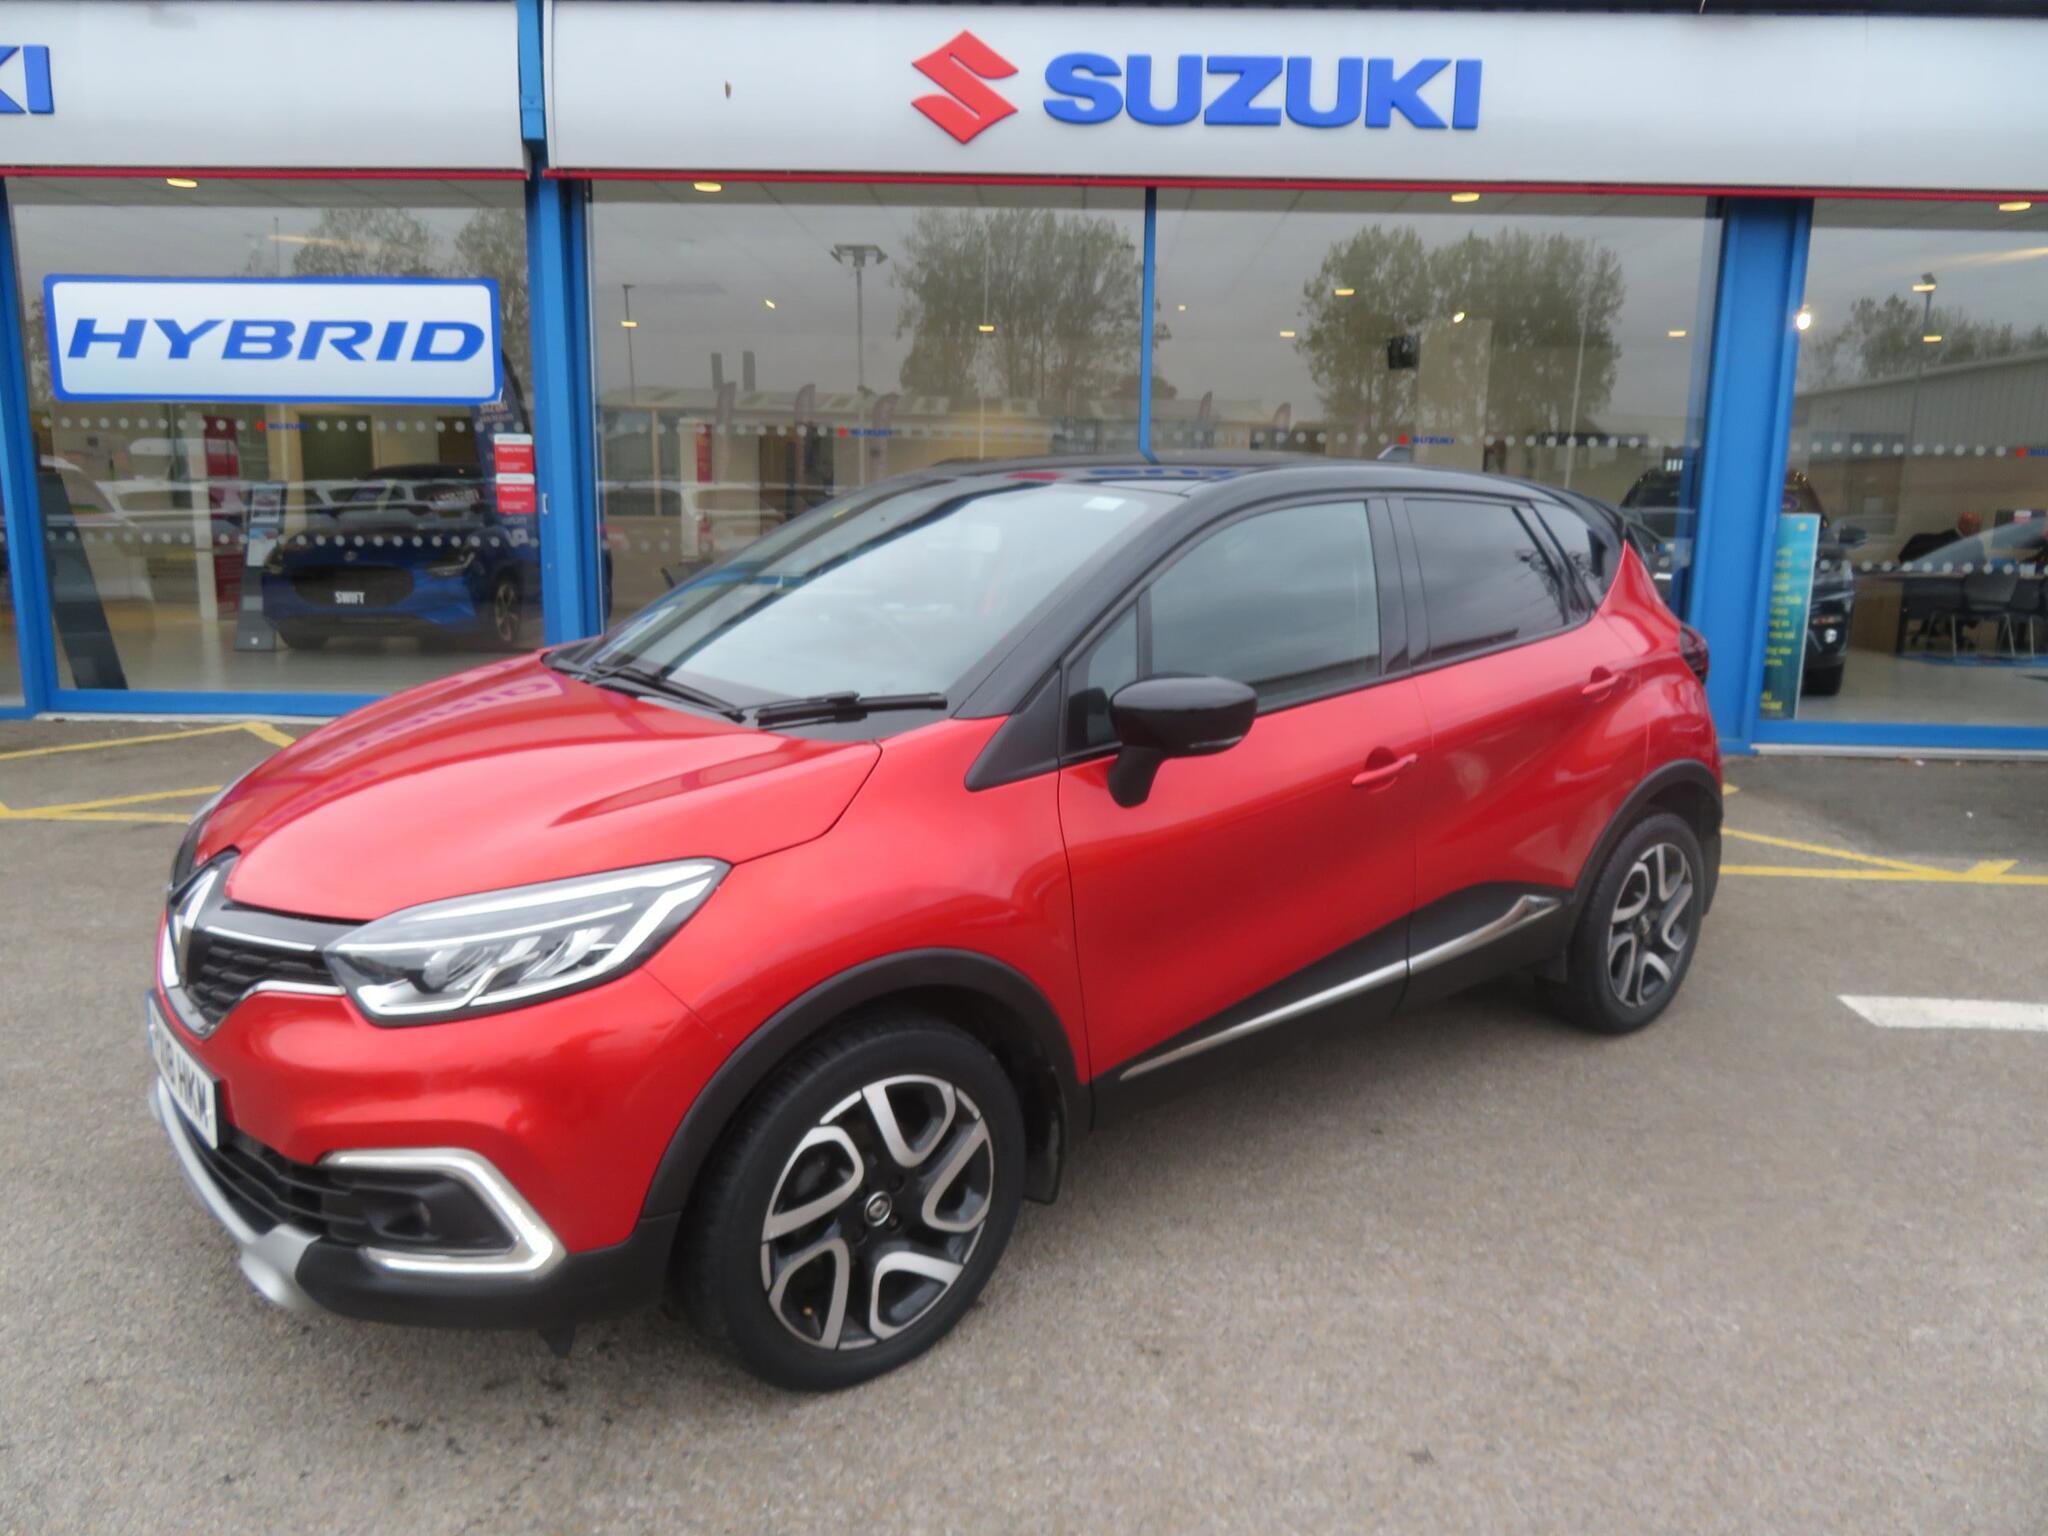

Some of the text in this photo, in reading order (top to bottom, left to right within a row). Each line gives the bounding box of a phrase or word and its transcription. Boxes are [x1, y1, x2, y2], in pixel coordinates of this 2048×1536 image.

[1043, 52, 1482, 130] SUZUKI
[67, 318, 485, 362] HYBRID
[335, 590, 365, 604] SWIFT
